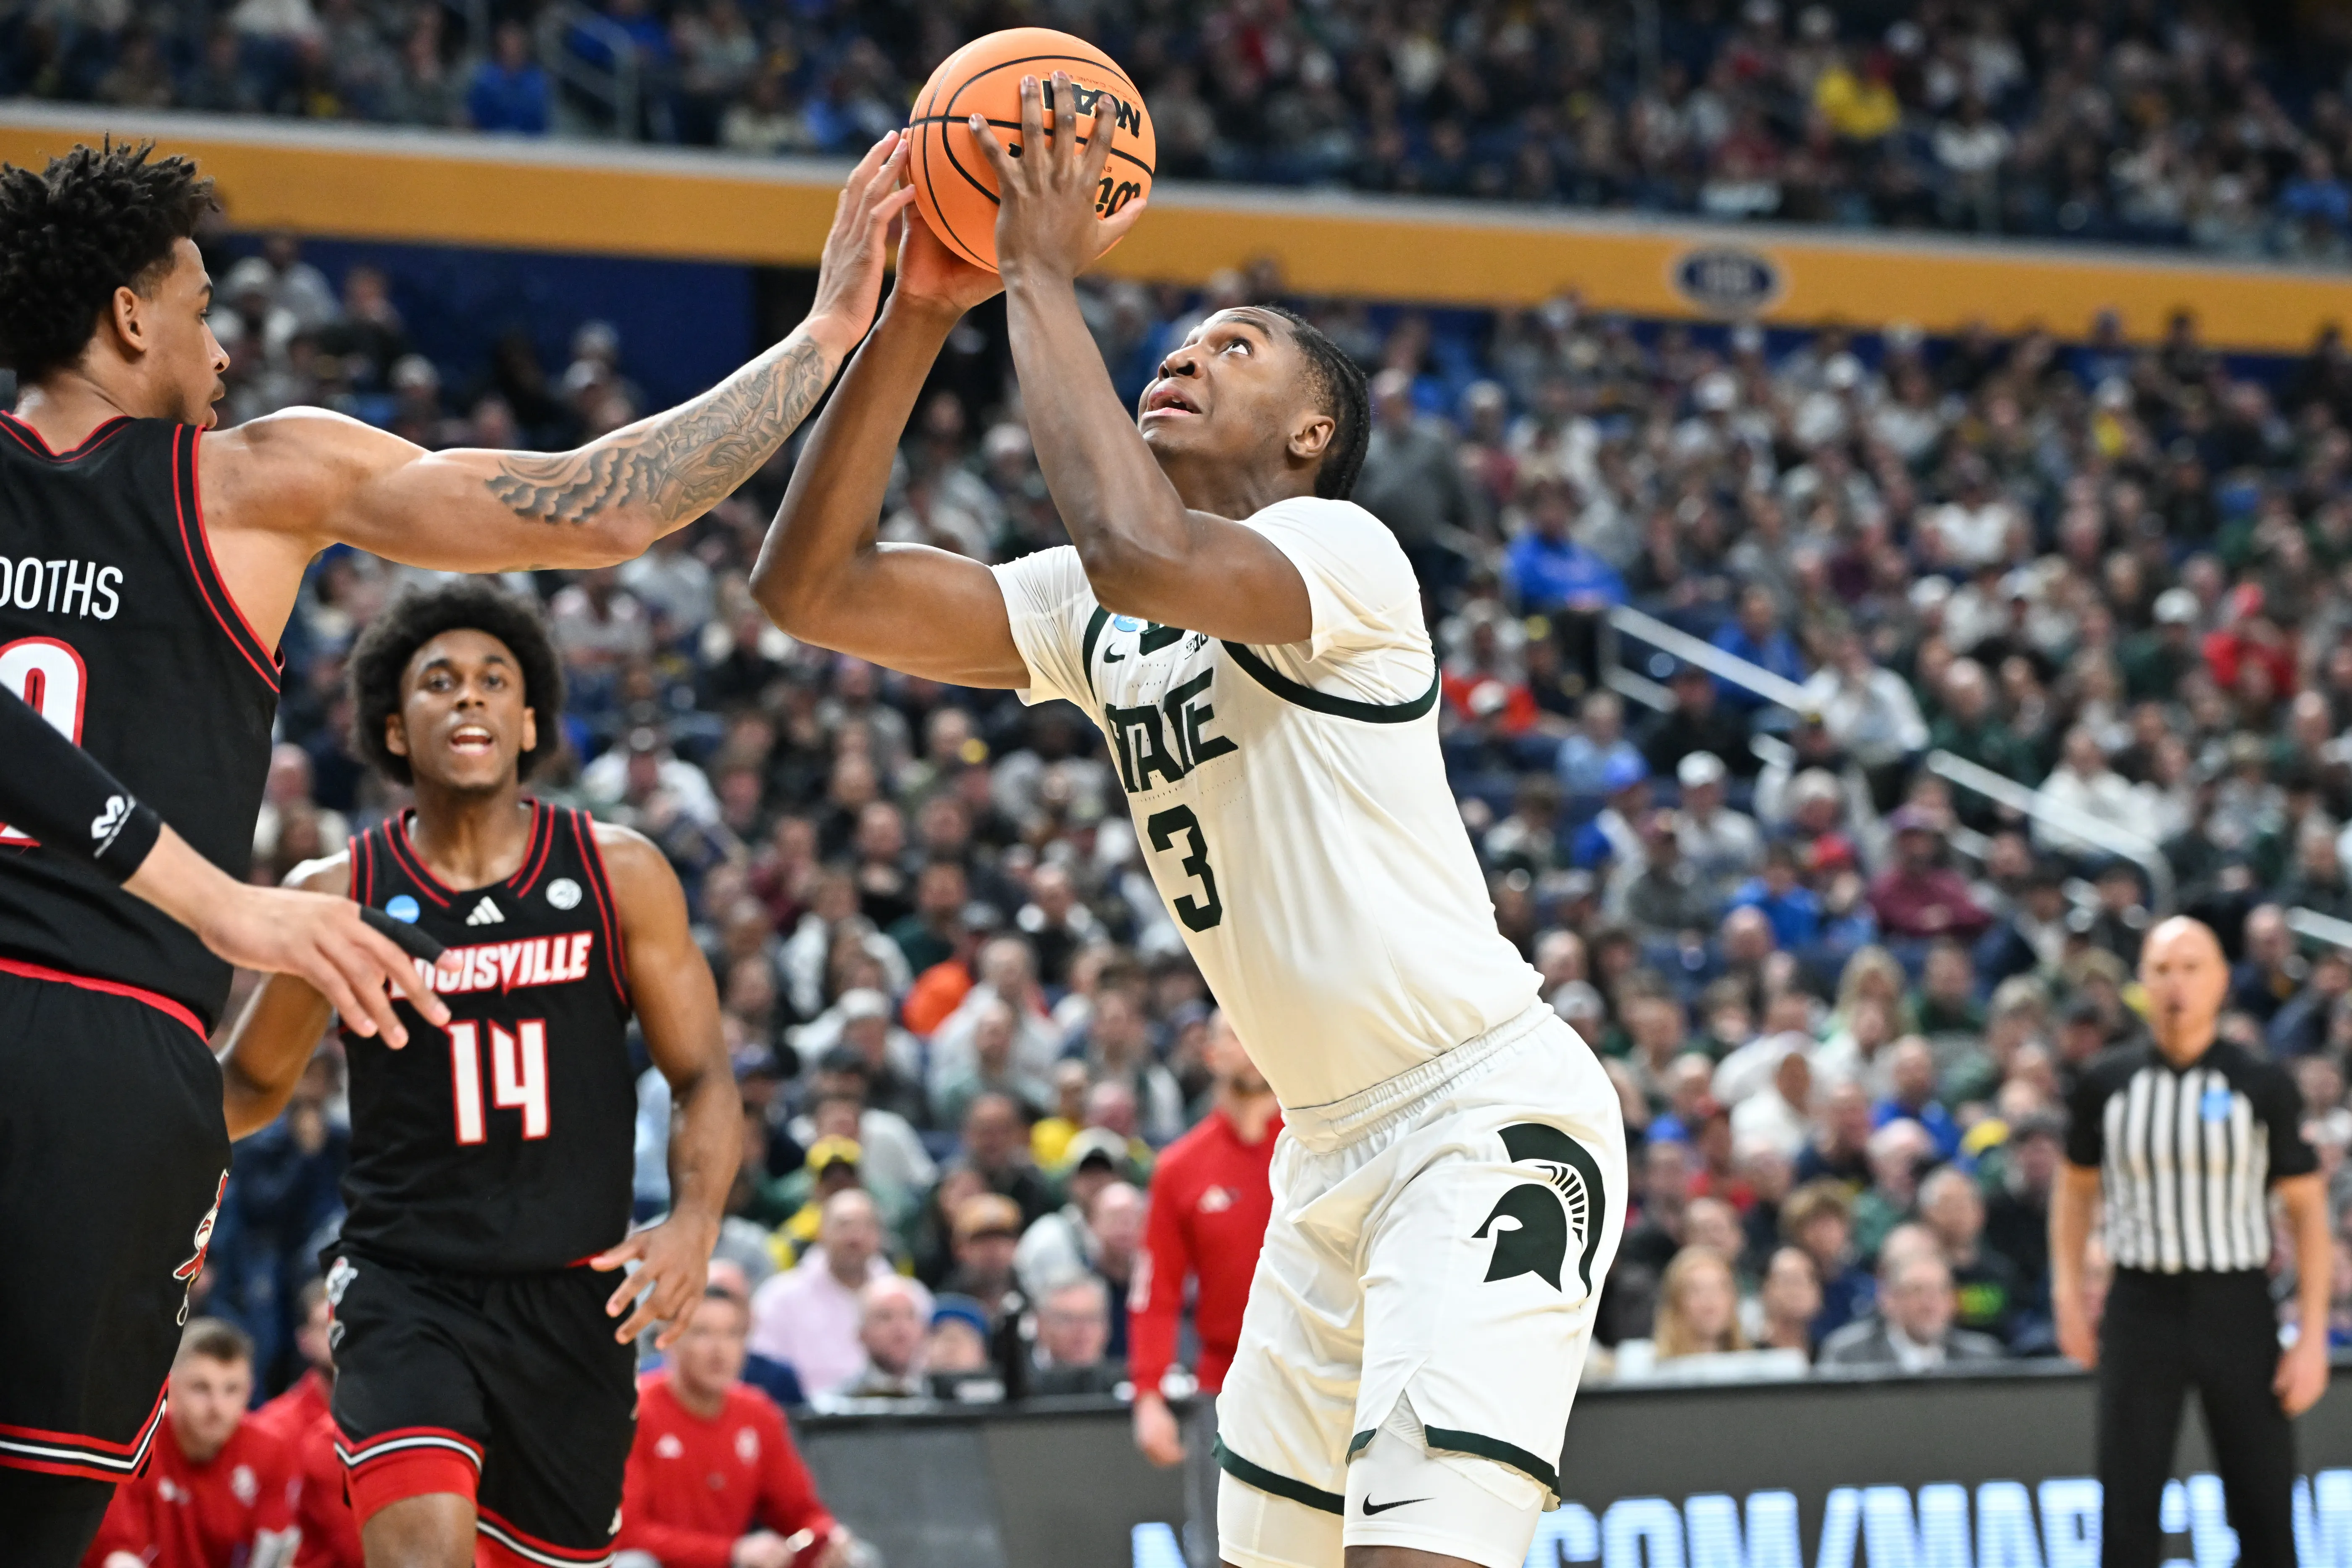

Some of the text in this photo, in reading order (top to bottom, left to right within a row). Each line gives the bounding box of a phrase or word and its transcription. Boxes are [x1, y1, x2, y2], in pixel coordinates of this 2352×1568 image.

[1105, 666, 1239, 794] TATE
[1147, 804, 1223, 933] 3
[441, 1017, 551, 1147] 14
